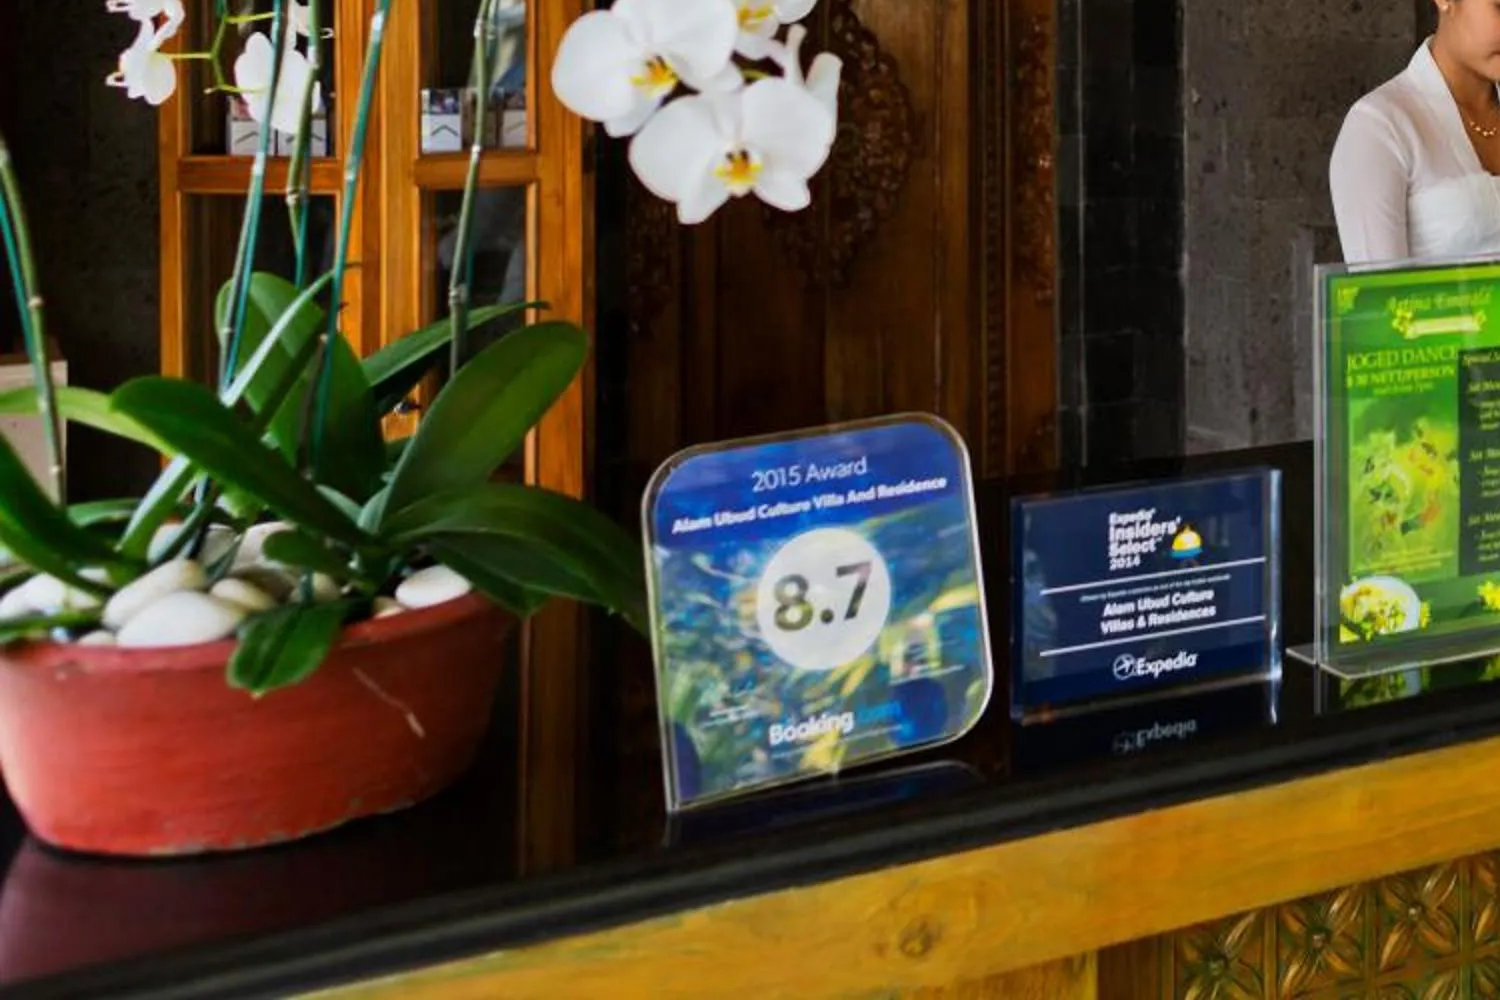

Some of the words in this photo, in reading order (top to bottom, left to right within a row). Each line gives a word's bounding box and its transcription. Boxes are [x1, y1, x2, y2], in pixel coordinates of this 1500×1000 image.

[1347, 349, 1399, 372] JOGED
[752, 465, 801, 492] 2015
[805, 456, 868, 483] Award
[672, 517, 712, 535] Alam
[713, 508, 756, 527] Ubud
[757, 499, 811, 519] Culture
[812, 493, 844, 511] Villa
[846, 486, 875, 504] And
[876, 477, 947, 498] Residence
[772, 560, 873, 632] 8.7
[1102, 602, 1135, 618] Alam
[1137, 594, 1170, 611] Ubud
[1171, 589, 1215, 606] Culture
[1100, 617, 1135, 635] Villas
[1136, 615, 1147, 629] &
[1147, 605, 1217, 626] Residences
[1136, 650, 1199, 679] Expedia
